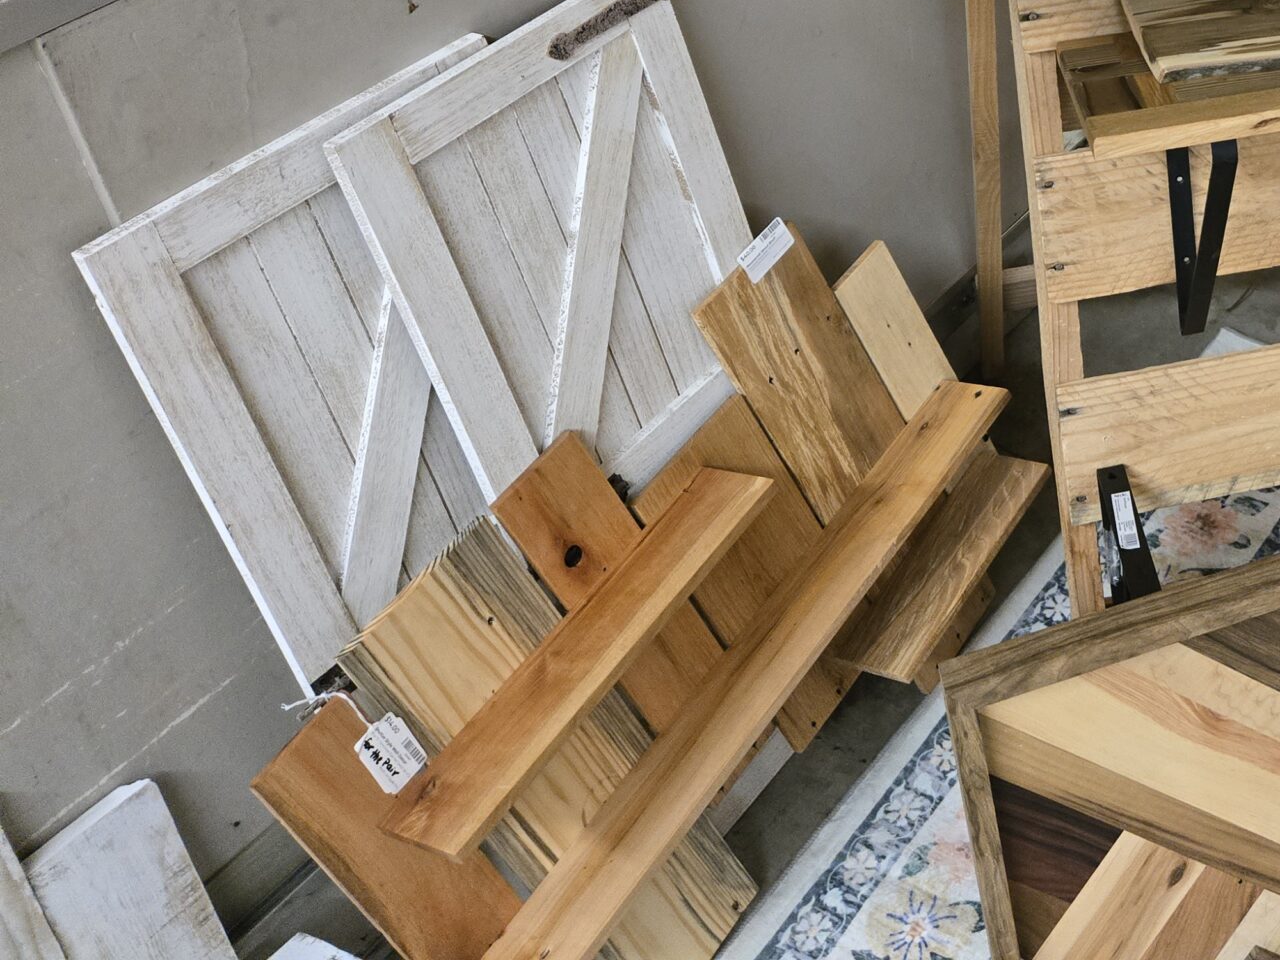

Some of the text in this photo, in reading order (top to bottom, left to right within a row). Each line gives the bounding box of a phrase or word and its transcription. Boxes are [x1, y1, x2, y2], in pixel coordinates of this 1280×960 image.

[363, 737, 375, 751] for
[370, 749, 383, 765] the
[382, 757, 400, 777] Pair
